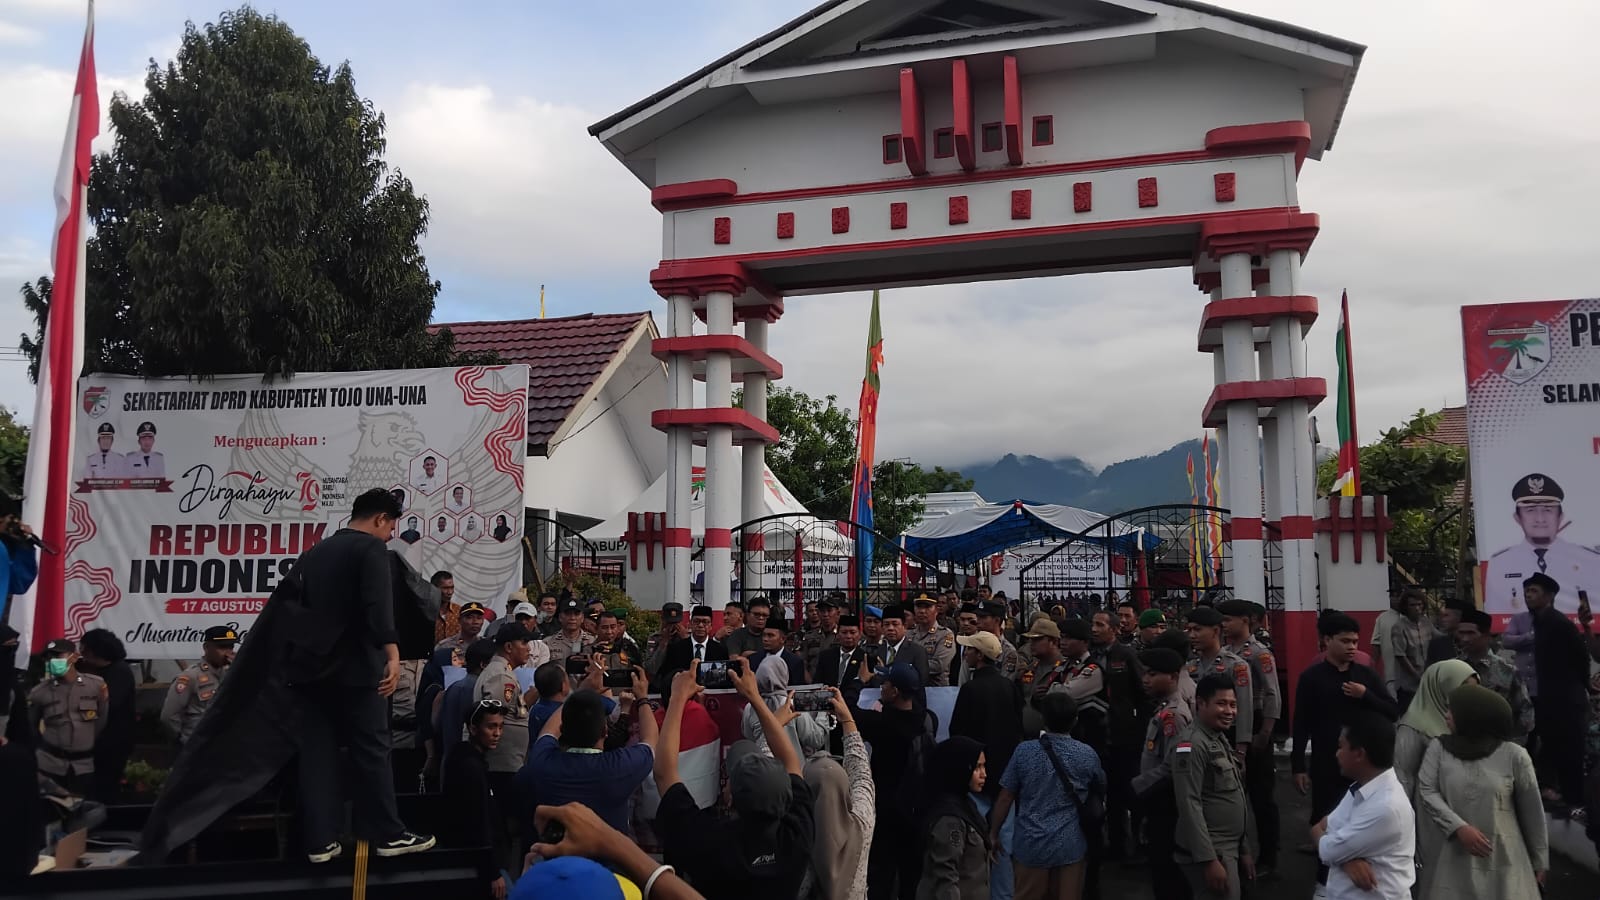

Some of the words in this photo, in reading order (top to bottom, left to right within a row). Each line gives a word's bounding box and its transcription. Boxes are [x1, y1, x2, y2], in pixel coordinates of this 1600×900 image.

[122, 391, 209, 412] SEKRETARIAT
[210, 389, 246, 410] DPRD
[248, 388, 328, 409] KABUPATEN
[329, 386, 363, 408] TOJO
[364, 385, 427, 407] UNA-UNA
[213, 433, 318, 451] Mengucapkan
[179, 463, 296, 520] Dirgahayu
[149, 523, 328, 555] REPUBLIK
[181, 600, 197, 612] 17
[199, 600, 264, 612] AGUSTUS
[125, 622, 206, 644] Nusantar
